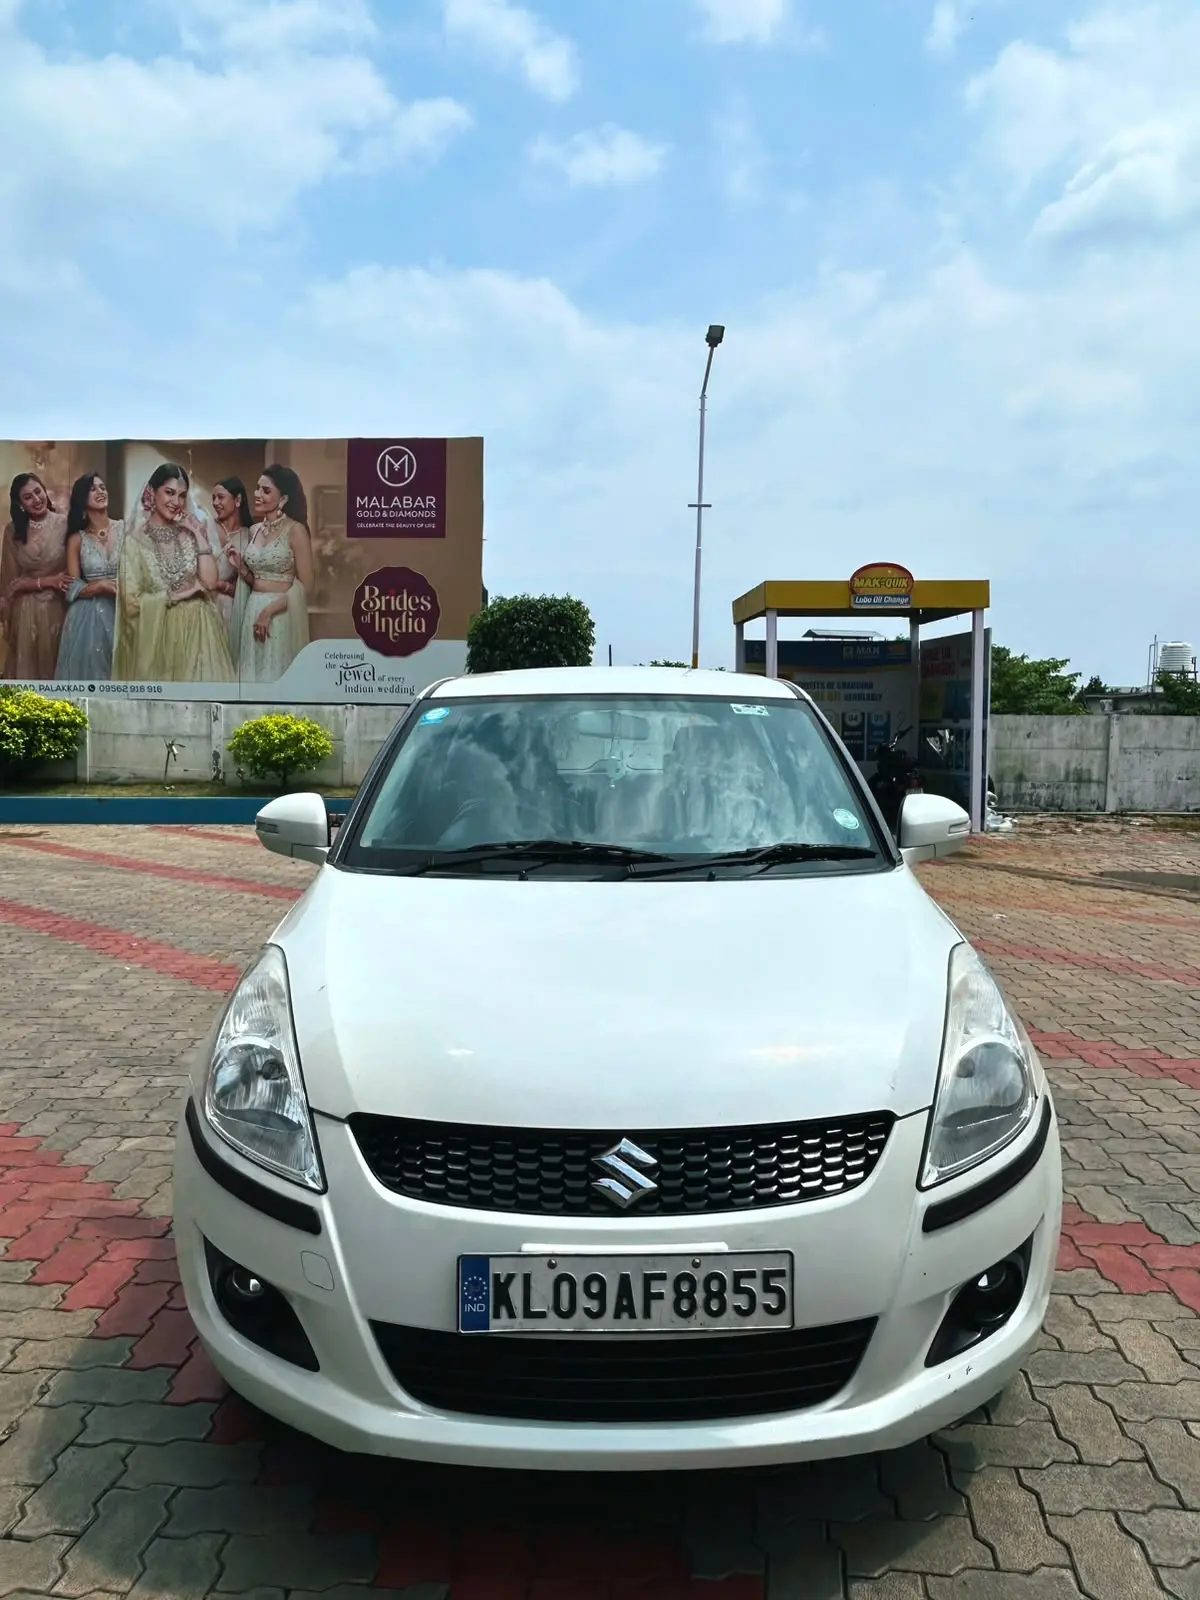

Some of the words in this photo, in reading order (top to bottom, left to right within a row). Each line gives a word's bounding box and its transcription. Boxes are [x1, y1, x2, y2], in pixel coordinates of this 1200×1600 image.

[356, 496, 436, 508] MALABAR
[356, 510, 381, 518] GOLD
[381, 510, 388, 518] &
[389, 510, 437, 518] DIAMONDS
[361, 585, 432, 611] Brides
[873, 595, 882, 604] Oil
[884, 595, 909, 605] Change
[361, 612, 374, 624] of
[375, 611, 426, 642] India
[324, 652, 364, 660] Celebrating
[335, 662, 376, 686] jewel
[39, 684, 85, 693] PALAKKAD
[98, 684, 128, 693] 09562
[345, 684, 374, 694] Indian
[378, 685, 415, 696] wedding
[492, 1268, 786, 1319] KL09AF8855
[464, 1303, 486, 1312] IND
